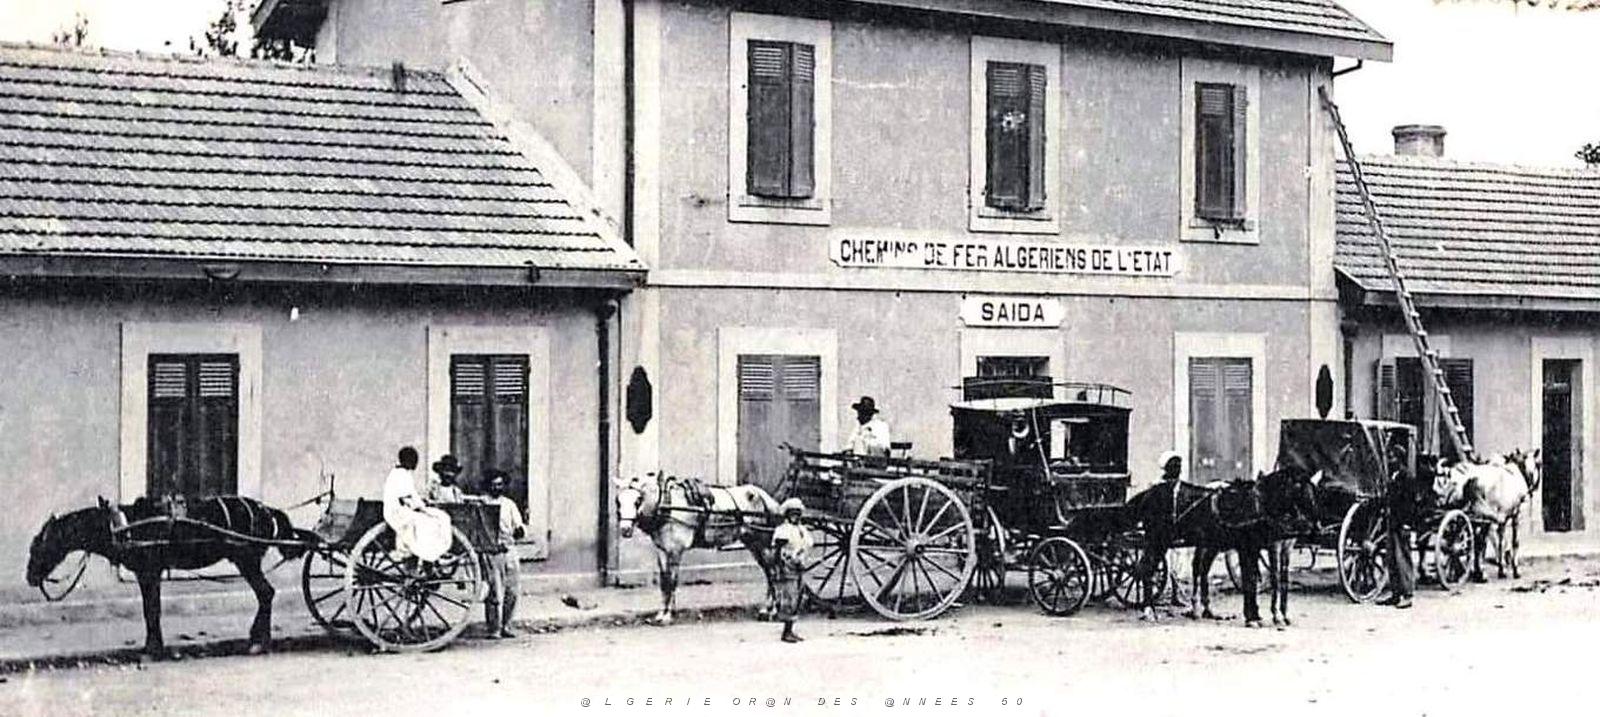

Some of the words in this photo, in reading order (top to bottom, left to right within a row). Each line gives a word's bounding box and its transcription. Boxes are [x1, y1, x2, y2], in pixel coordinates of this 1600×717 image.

[924, 242, 948, 266] DE
[953, 244, 988, 267] FER
[993, 245, 1087, 270] ALGERIENS
[1092, 249, 1113, 271] DE
[1117, 249, 1172, 272] L'ETAT
[981, 302, 1045, 322] SAIDA
